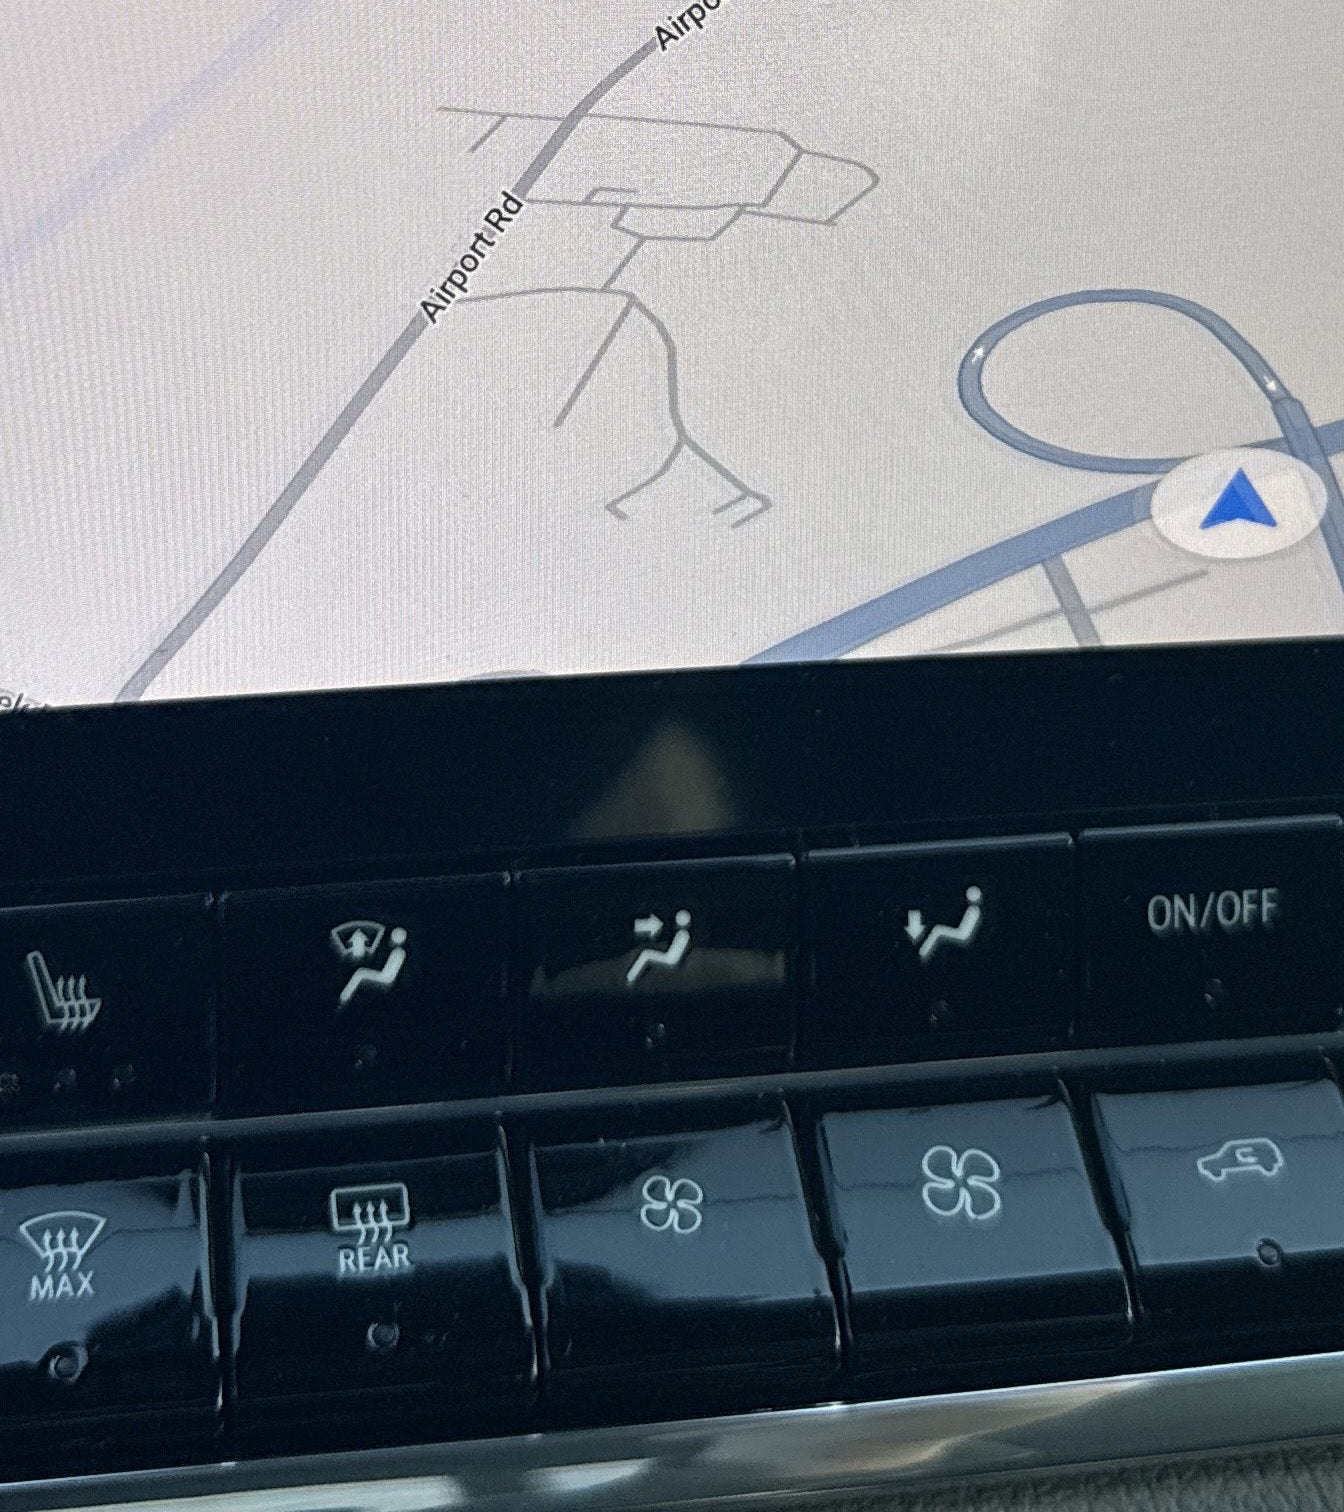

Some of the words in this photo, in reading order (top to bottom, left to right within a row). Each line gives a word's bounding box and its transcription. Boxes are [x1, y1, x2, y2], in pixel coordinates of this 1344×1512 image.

[420, 231, 496, 324] Airport
[484, 190, 524, 233] Rd
[1147, 889, 1278, 934] ON/OFF
[337, 1244, 412, 1274] REAR
[28, 1272, 96, 1301] MAX
